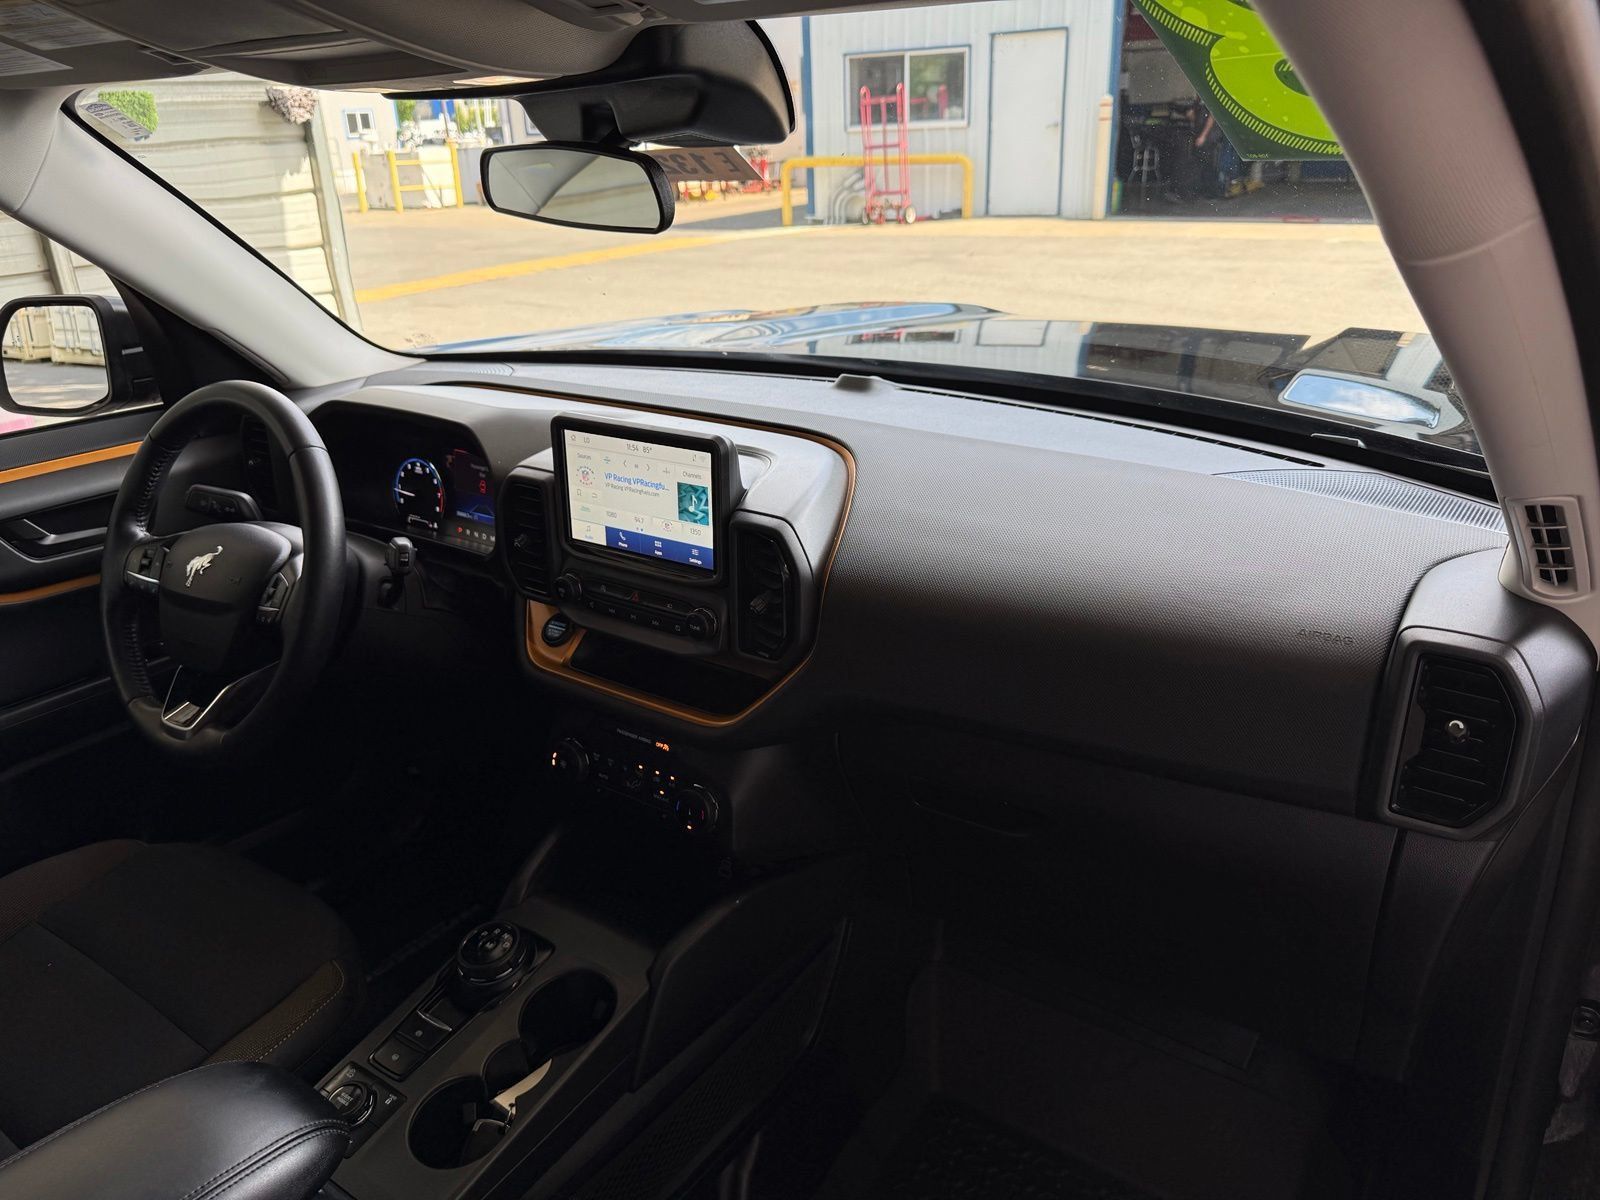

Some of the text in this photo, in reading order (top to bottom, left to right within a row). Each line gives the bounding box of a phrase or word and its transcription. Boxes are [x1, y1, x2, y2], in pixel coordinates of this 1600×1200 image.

[626, 443, 639, 452] 11:54
[604, 472, 613, 480] VP
[613, 474, 632, 486] Racing
[611, 483, 624, 492] Racing
[690, 528, 702, 536] 1350
